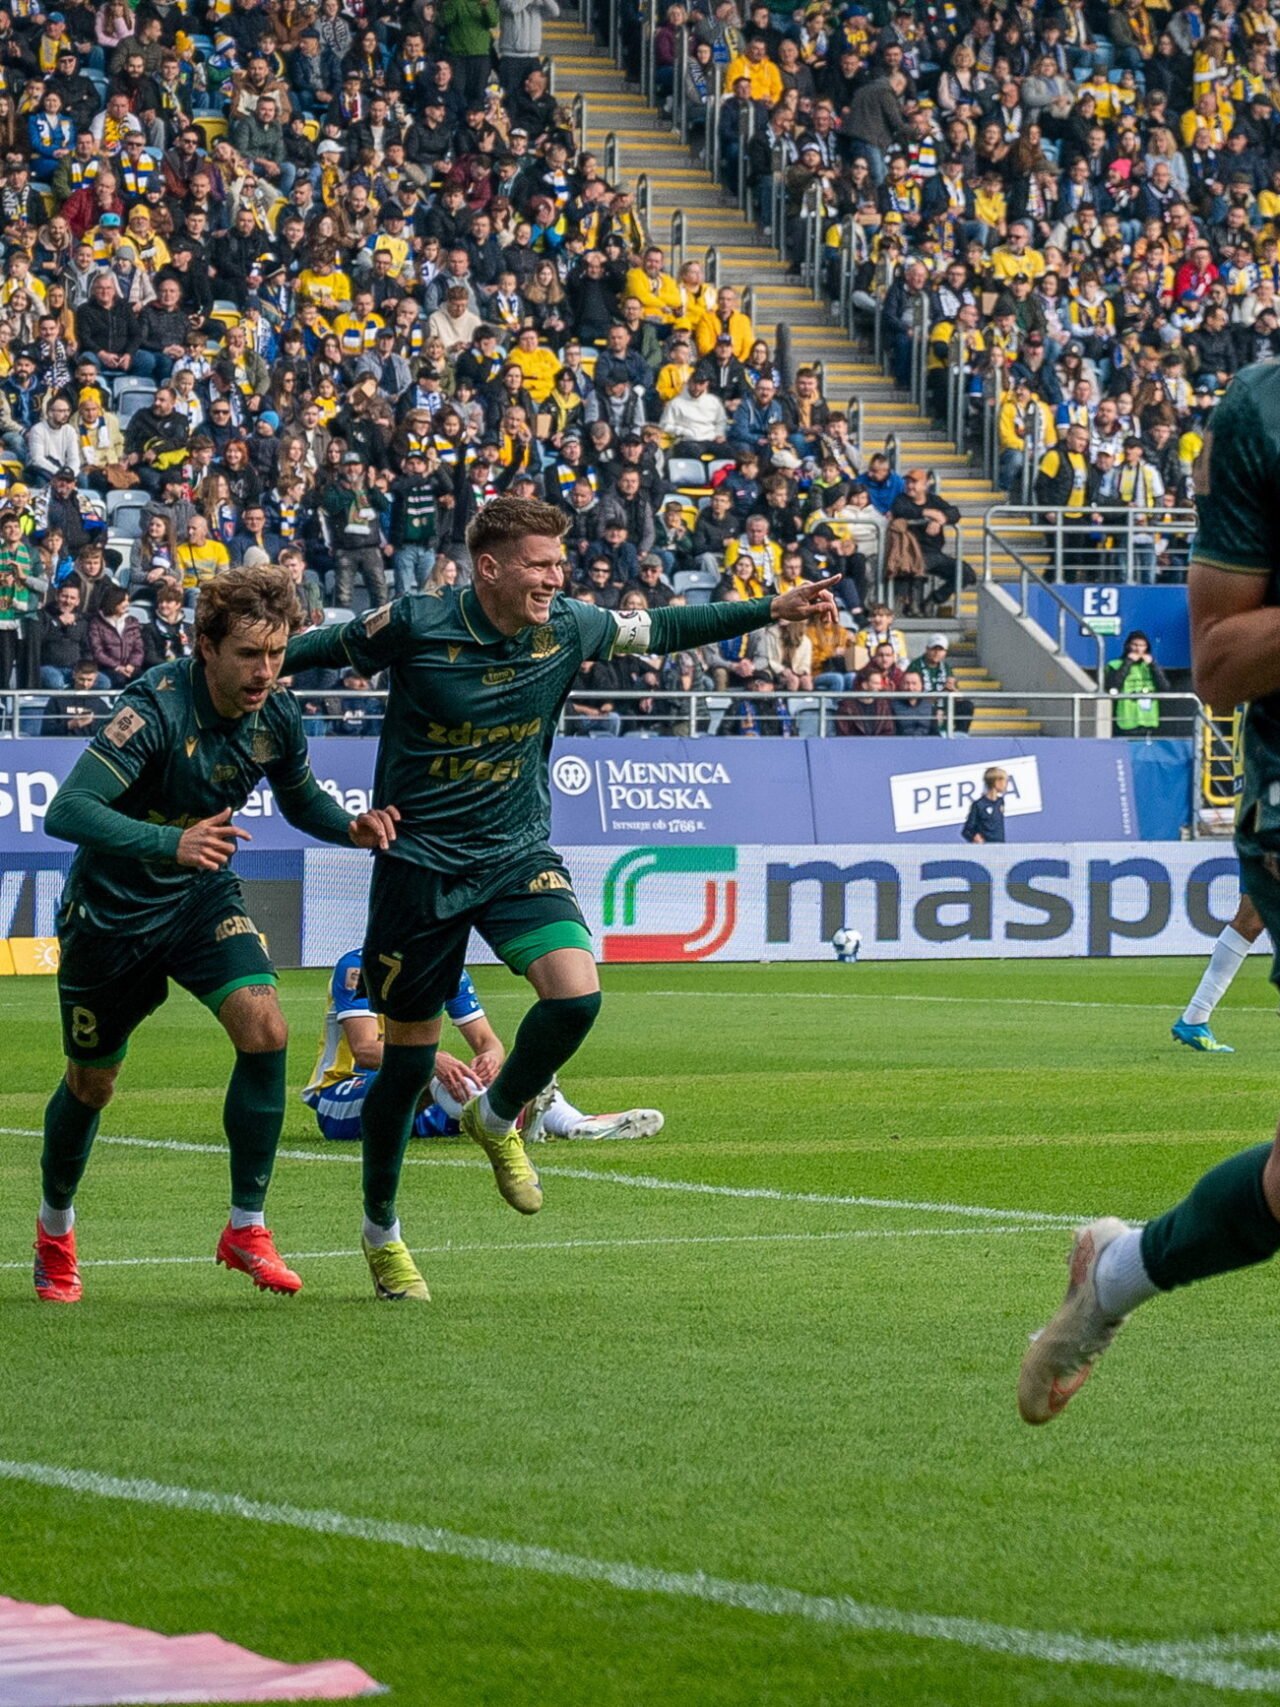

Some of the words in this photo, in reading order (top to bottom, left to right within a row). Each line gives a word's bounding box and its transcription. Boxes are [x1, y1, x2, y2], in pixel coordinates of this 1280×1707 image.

[1083, 586, 1119, 615] E3
[605, 760, 732, 784] MENNICA
[608, 785, 713, 810] POLSKA
[912, 774, 1021, 814] PERA
[766, 857, 1240, 956] maspo
[378, 953, 402, 1001] 7
[71, 1006, 99, 1048] 8
